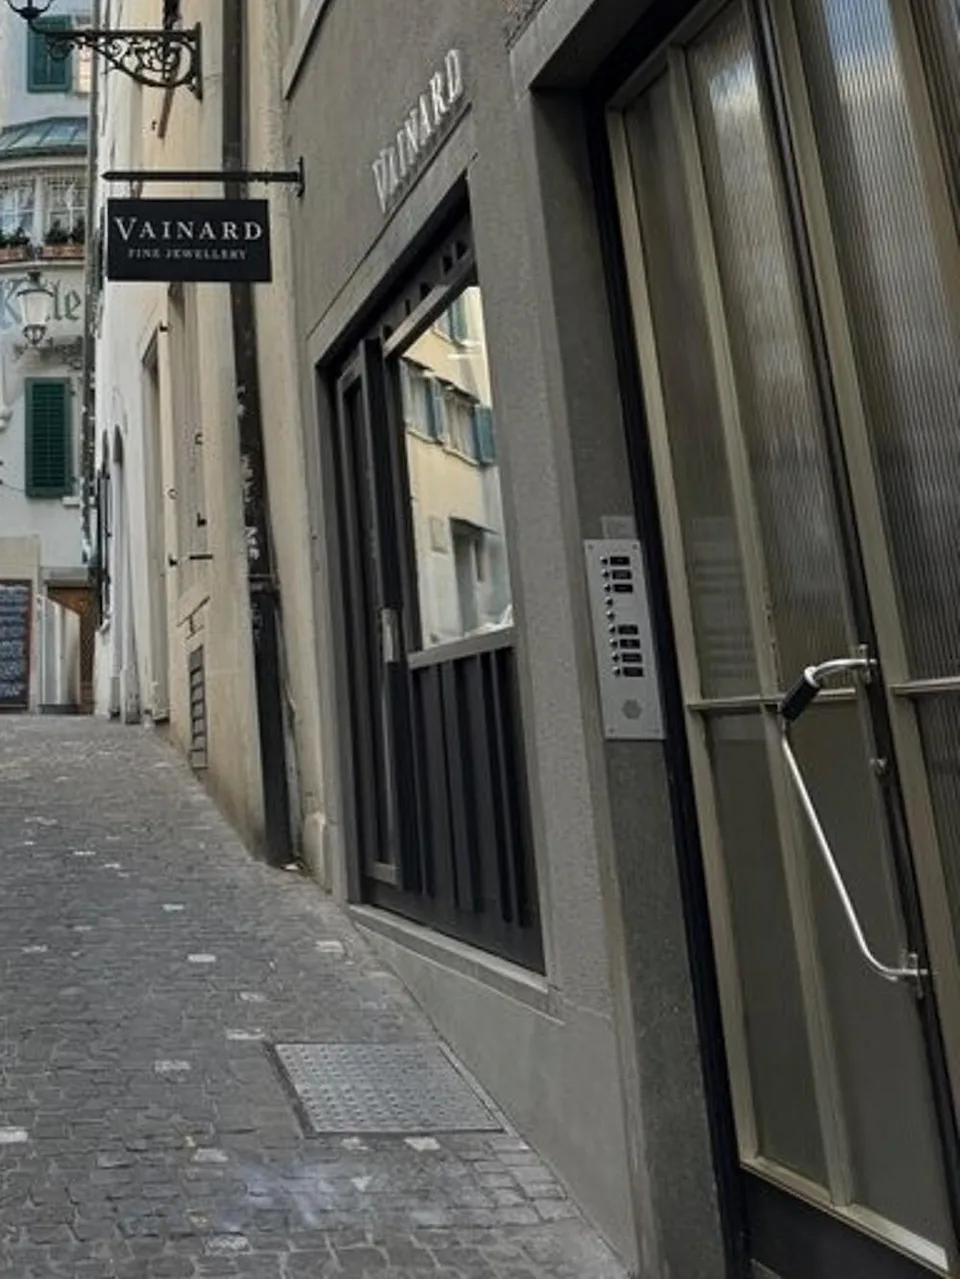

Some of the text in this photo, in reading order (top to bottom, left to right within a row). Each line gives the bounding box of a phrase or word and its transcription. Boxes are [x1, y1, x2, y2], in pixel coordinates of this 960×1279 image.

[113, 216, 264, 241] VAINARD
[128, 248, 247, 261] FINE JEWELLERY
